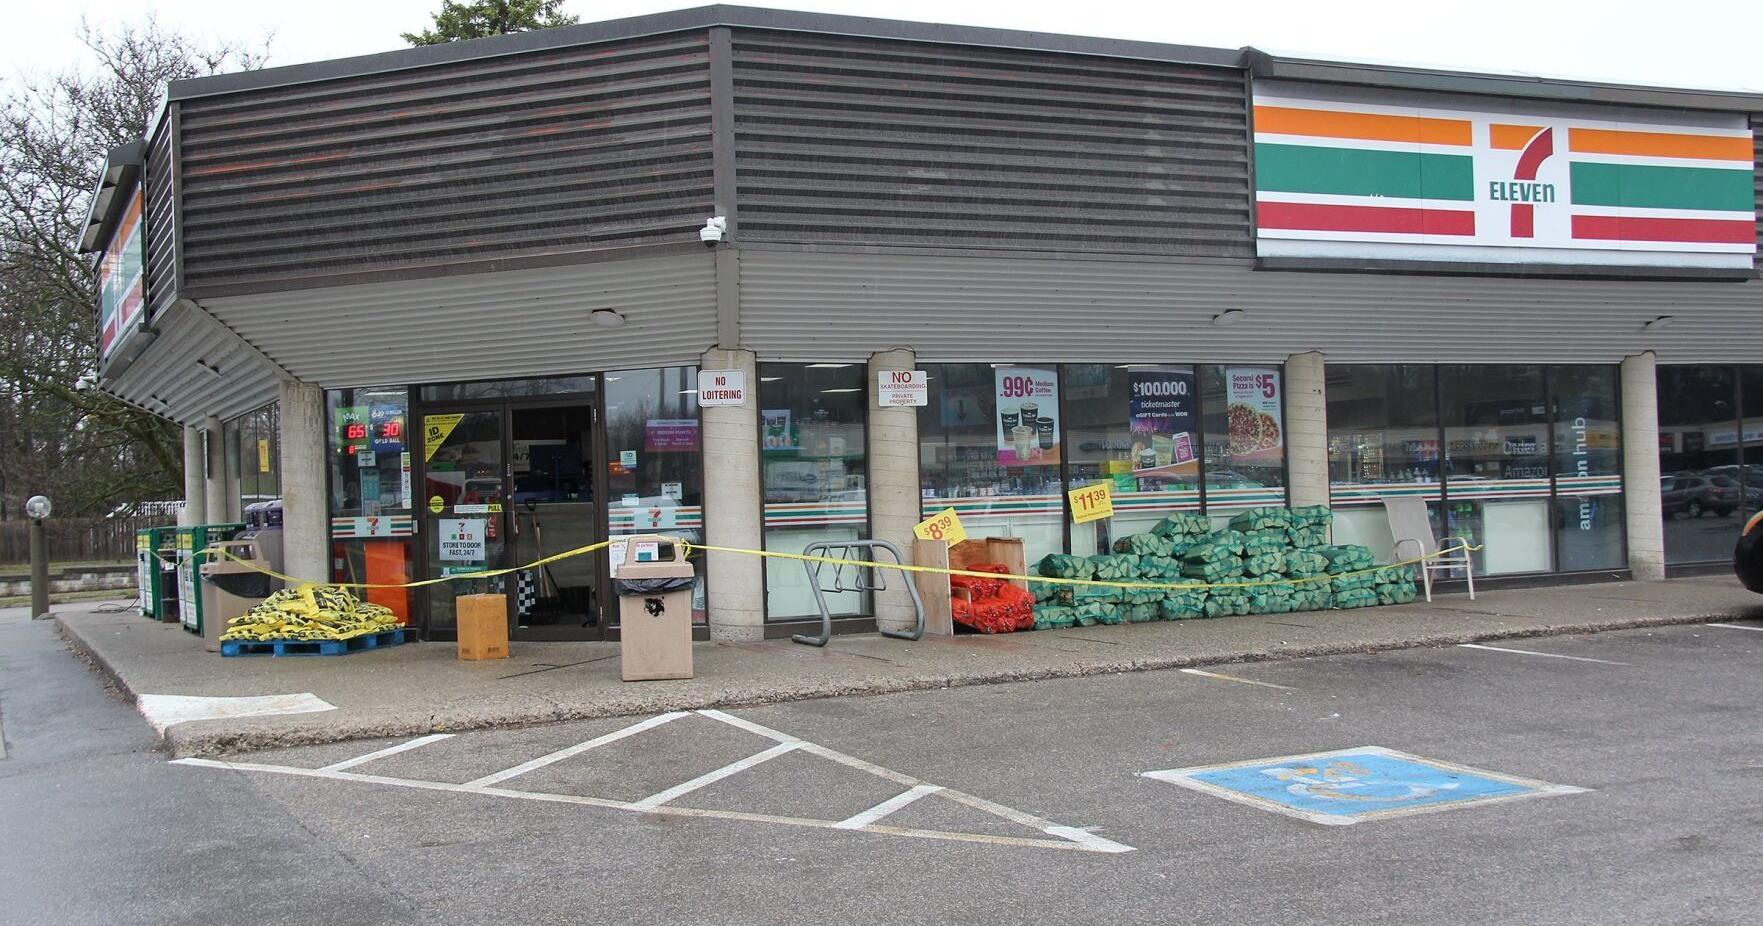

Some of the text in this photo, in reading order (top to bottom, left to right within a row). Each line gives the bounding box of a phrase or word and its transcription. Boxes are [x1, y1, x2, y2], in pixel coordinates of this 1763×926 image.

[715, 376, 726, 386] NO
[892, 371, 912, 383] NO
[1232, 374, 1254, 382] Second
[1255, 373, 1276, 399] $5
[702, 389, 742, 400] LOITERING
[1141, 400, 1181, 409] ticketmaster
[348, 425, 365, 439] 65
[383, 423, 399, 437] 30
[428, 426, 440, 437] ID
[427, 432, 445, 444] ZONE
[1571, 417, 1588, 455] hub
[443, 541, 481, 549] STORE TO DOOR
